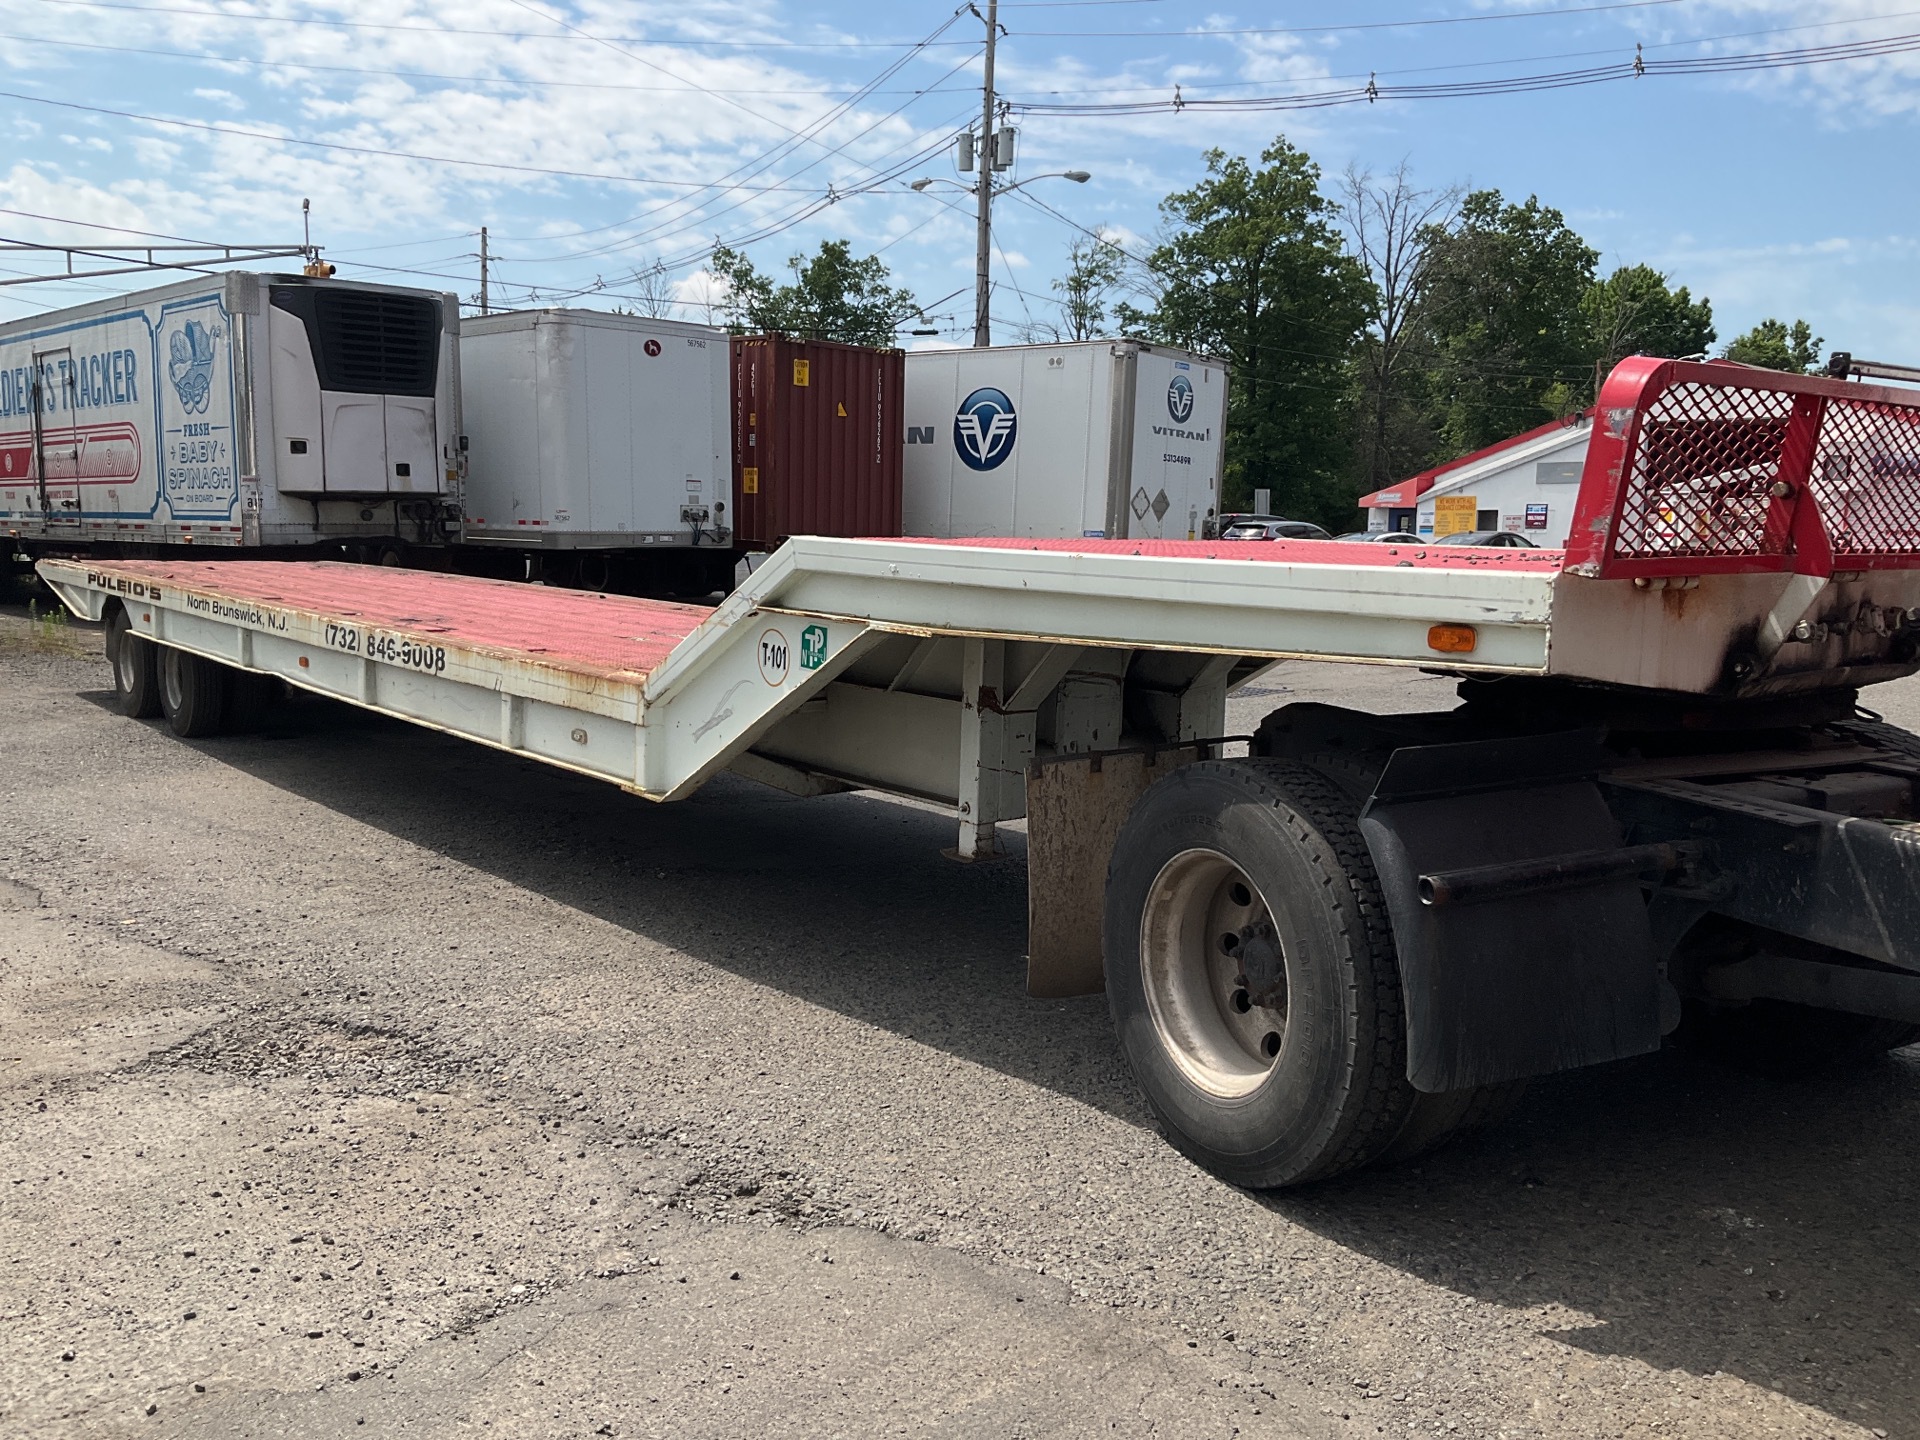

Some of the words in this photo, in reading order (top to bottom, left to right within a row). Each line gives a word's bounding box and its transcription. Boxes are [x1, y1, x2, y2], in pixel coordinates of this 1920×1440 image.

[58, 348, 138, 411] TRACKER
[183, 422, 210, 437] FRESH
[903, 426, 934, 444] N
[1152, 425, 1205, 441] VITRAN
[178, 440, 218, 464] BABY
[168, 466, 231, 490] SPINACH
[185, 494, 194, 503] ON
[195, 494, 214, 503] BOARD
[88, 573, 161, 600] PULEIO'S
[187, 595, 210, 612] North
[212, 601, 265, 629] Brunswick,
[268, 614, 289, 631] N.J.
[325, 623, 361, 652] (732)
[367, 634, 446, 671] 846-9008
[762, 642, 787, 670] T-101
